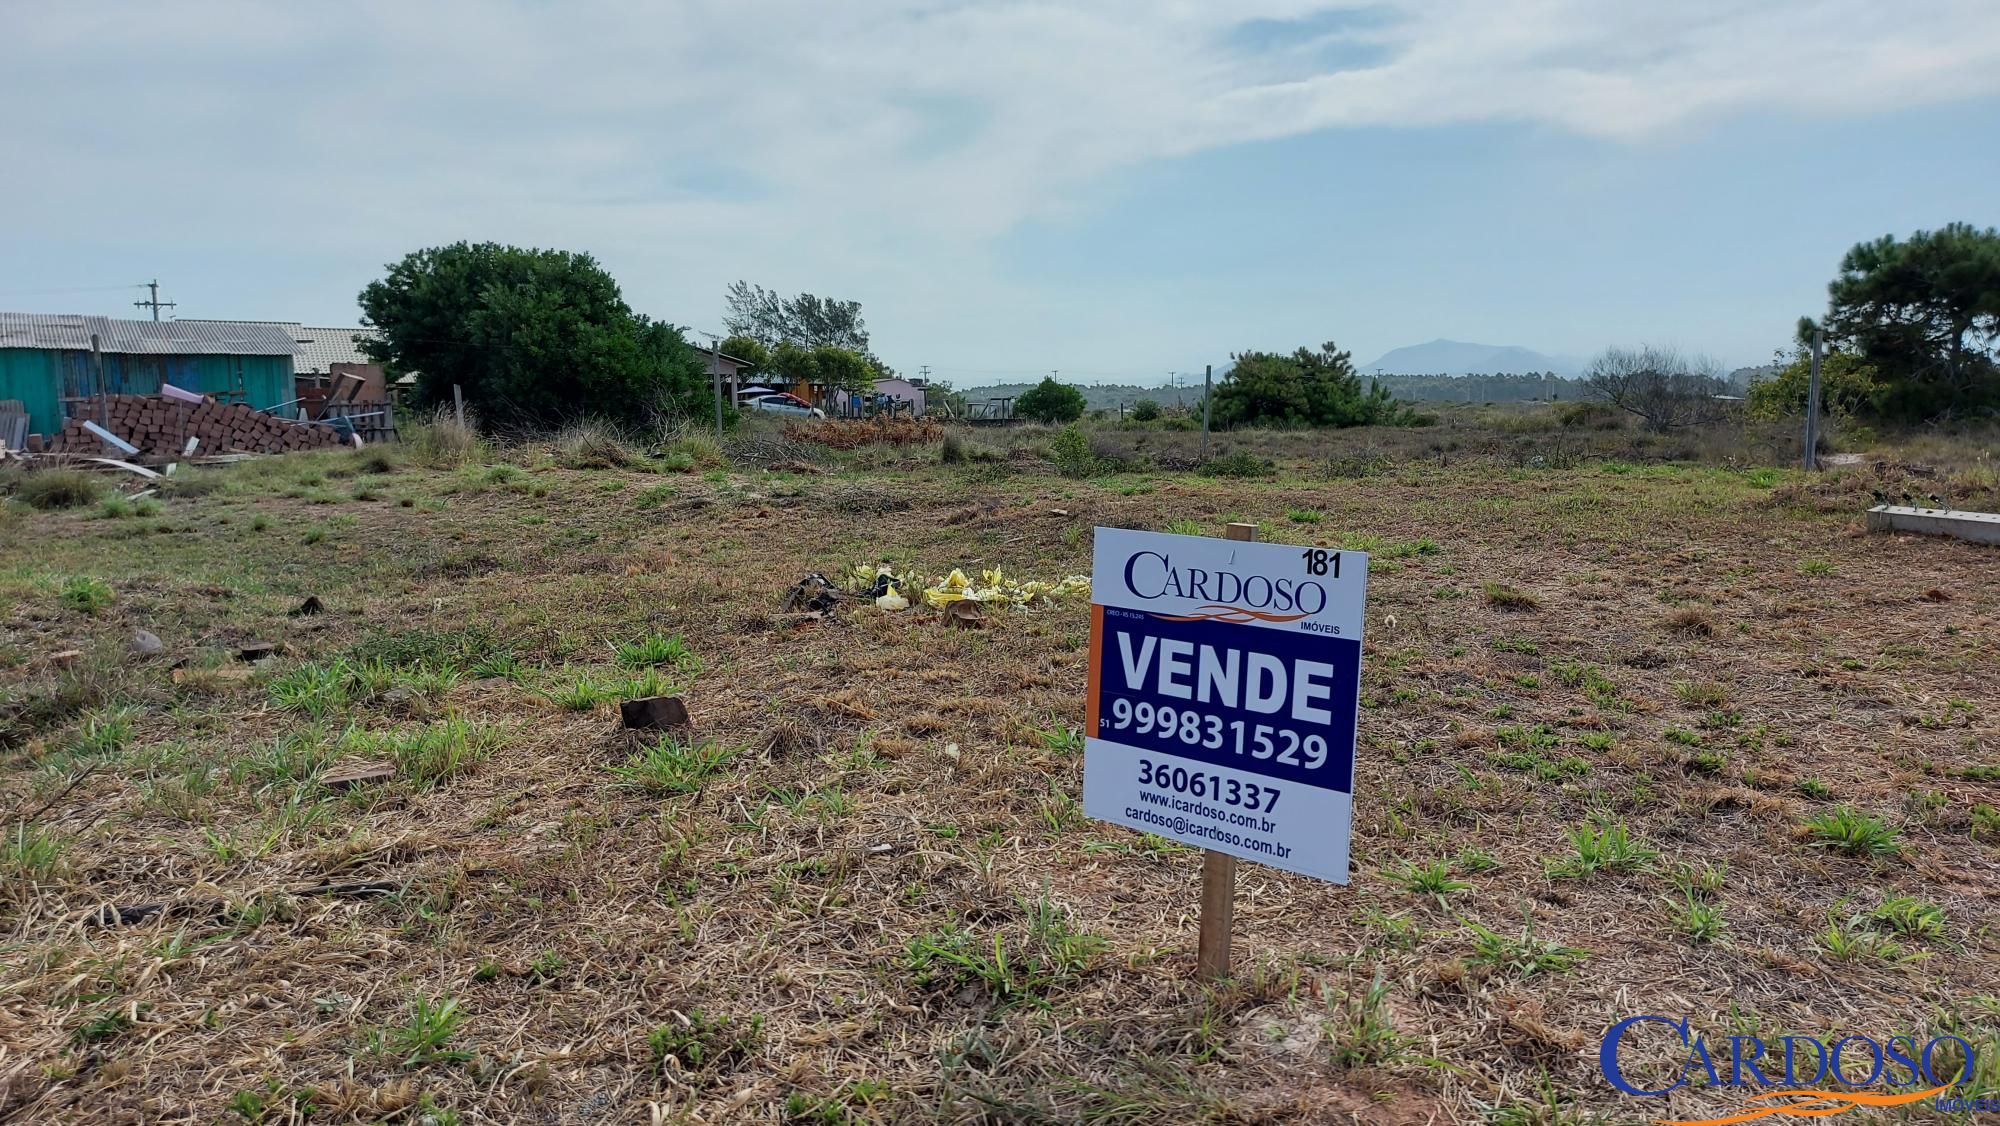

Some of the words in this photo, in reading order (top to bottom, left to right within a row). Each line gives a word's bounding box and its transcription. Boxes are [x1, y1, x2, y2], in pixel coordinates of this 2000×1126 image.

[1124, 551, 1327, 614] CARDOSO
[1302, 548, 1341, 578] 181
[1300, 620, 1340, 635] IMÓVEIS
[1116, 631, 1334, 726] VENDE
[1099, 718, 1110, 728] 51
[1112, 698, 1328, 770] 999831529
[1138, 759, 1281, 814] 36061337
[1139, 789, 1276, 834] www.icardoso.com.br
[1125, 805, 1292, 859] cardoso@icardoso.com.br
